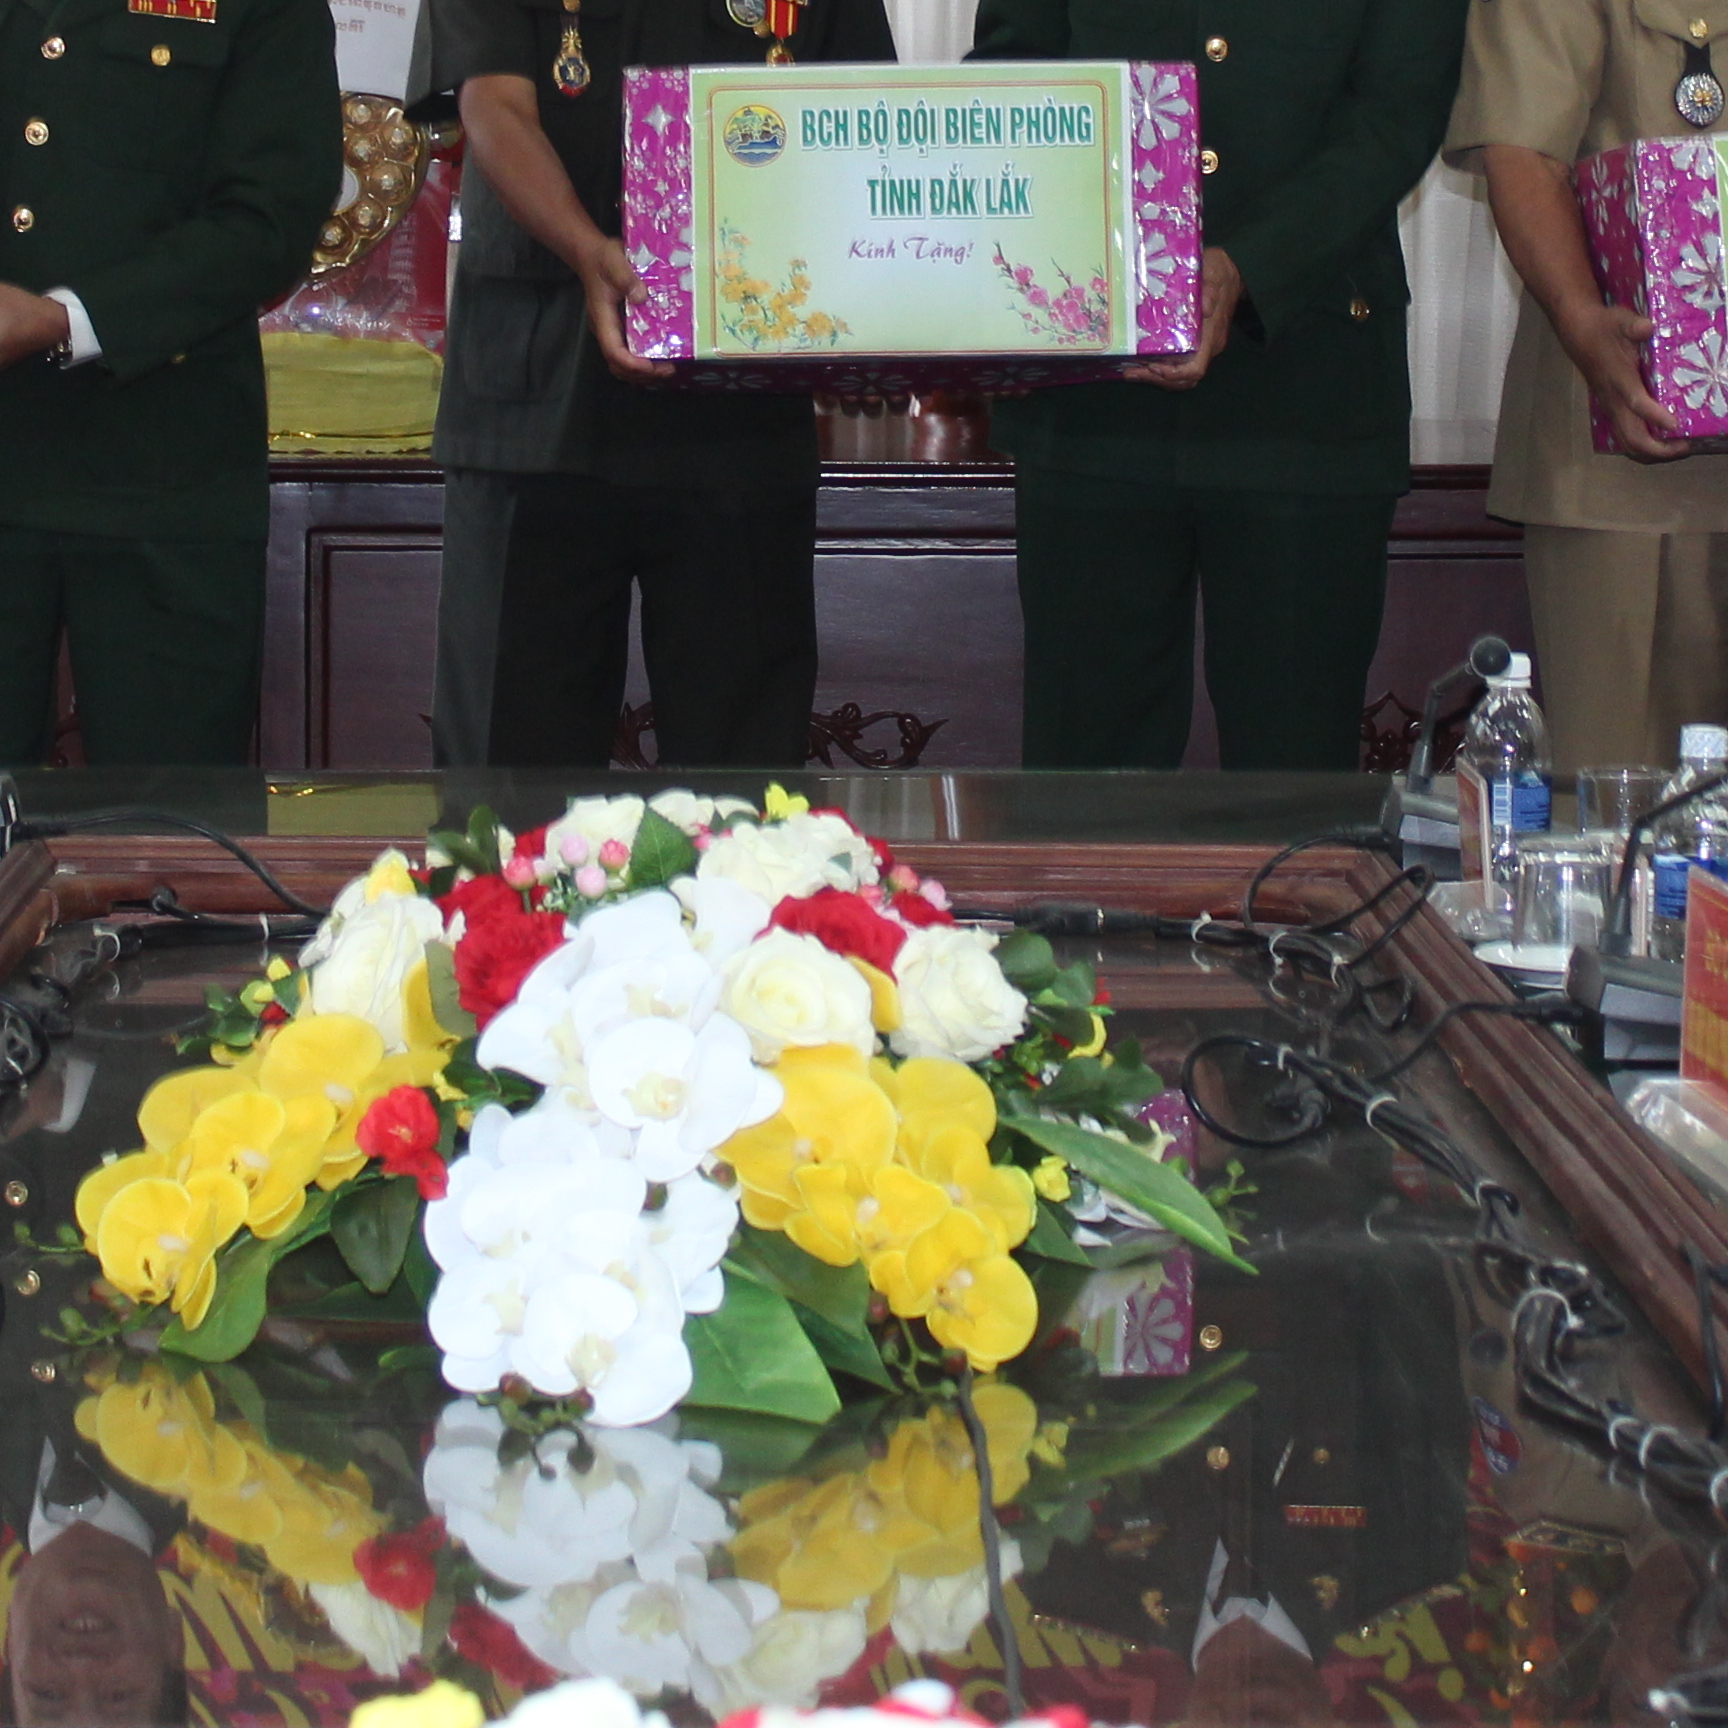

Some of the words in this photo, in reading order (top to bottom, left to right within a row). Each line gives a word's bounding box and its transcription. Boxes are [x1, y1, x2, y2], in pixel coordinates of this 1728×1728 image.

[800, 108, 849, 147] BCH
[856, 99, 889, 155] BỘ
[896, 99, 938, 155] ĐỘI
[944, 98, 1003, 146] BIÊN
[1009, 97, 1092, 146] PHÒNG
[866, 164, 923, 217] TỈNH
[930, 161, 980, 217] ĐẮK
[985, 161, 1032, 217] LẮK
[902, 235, 975, 266] Tặng!
